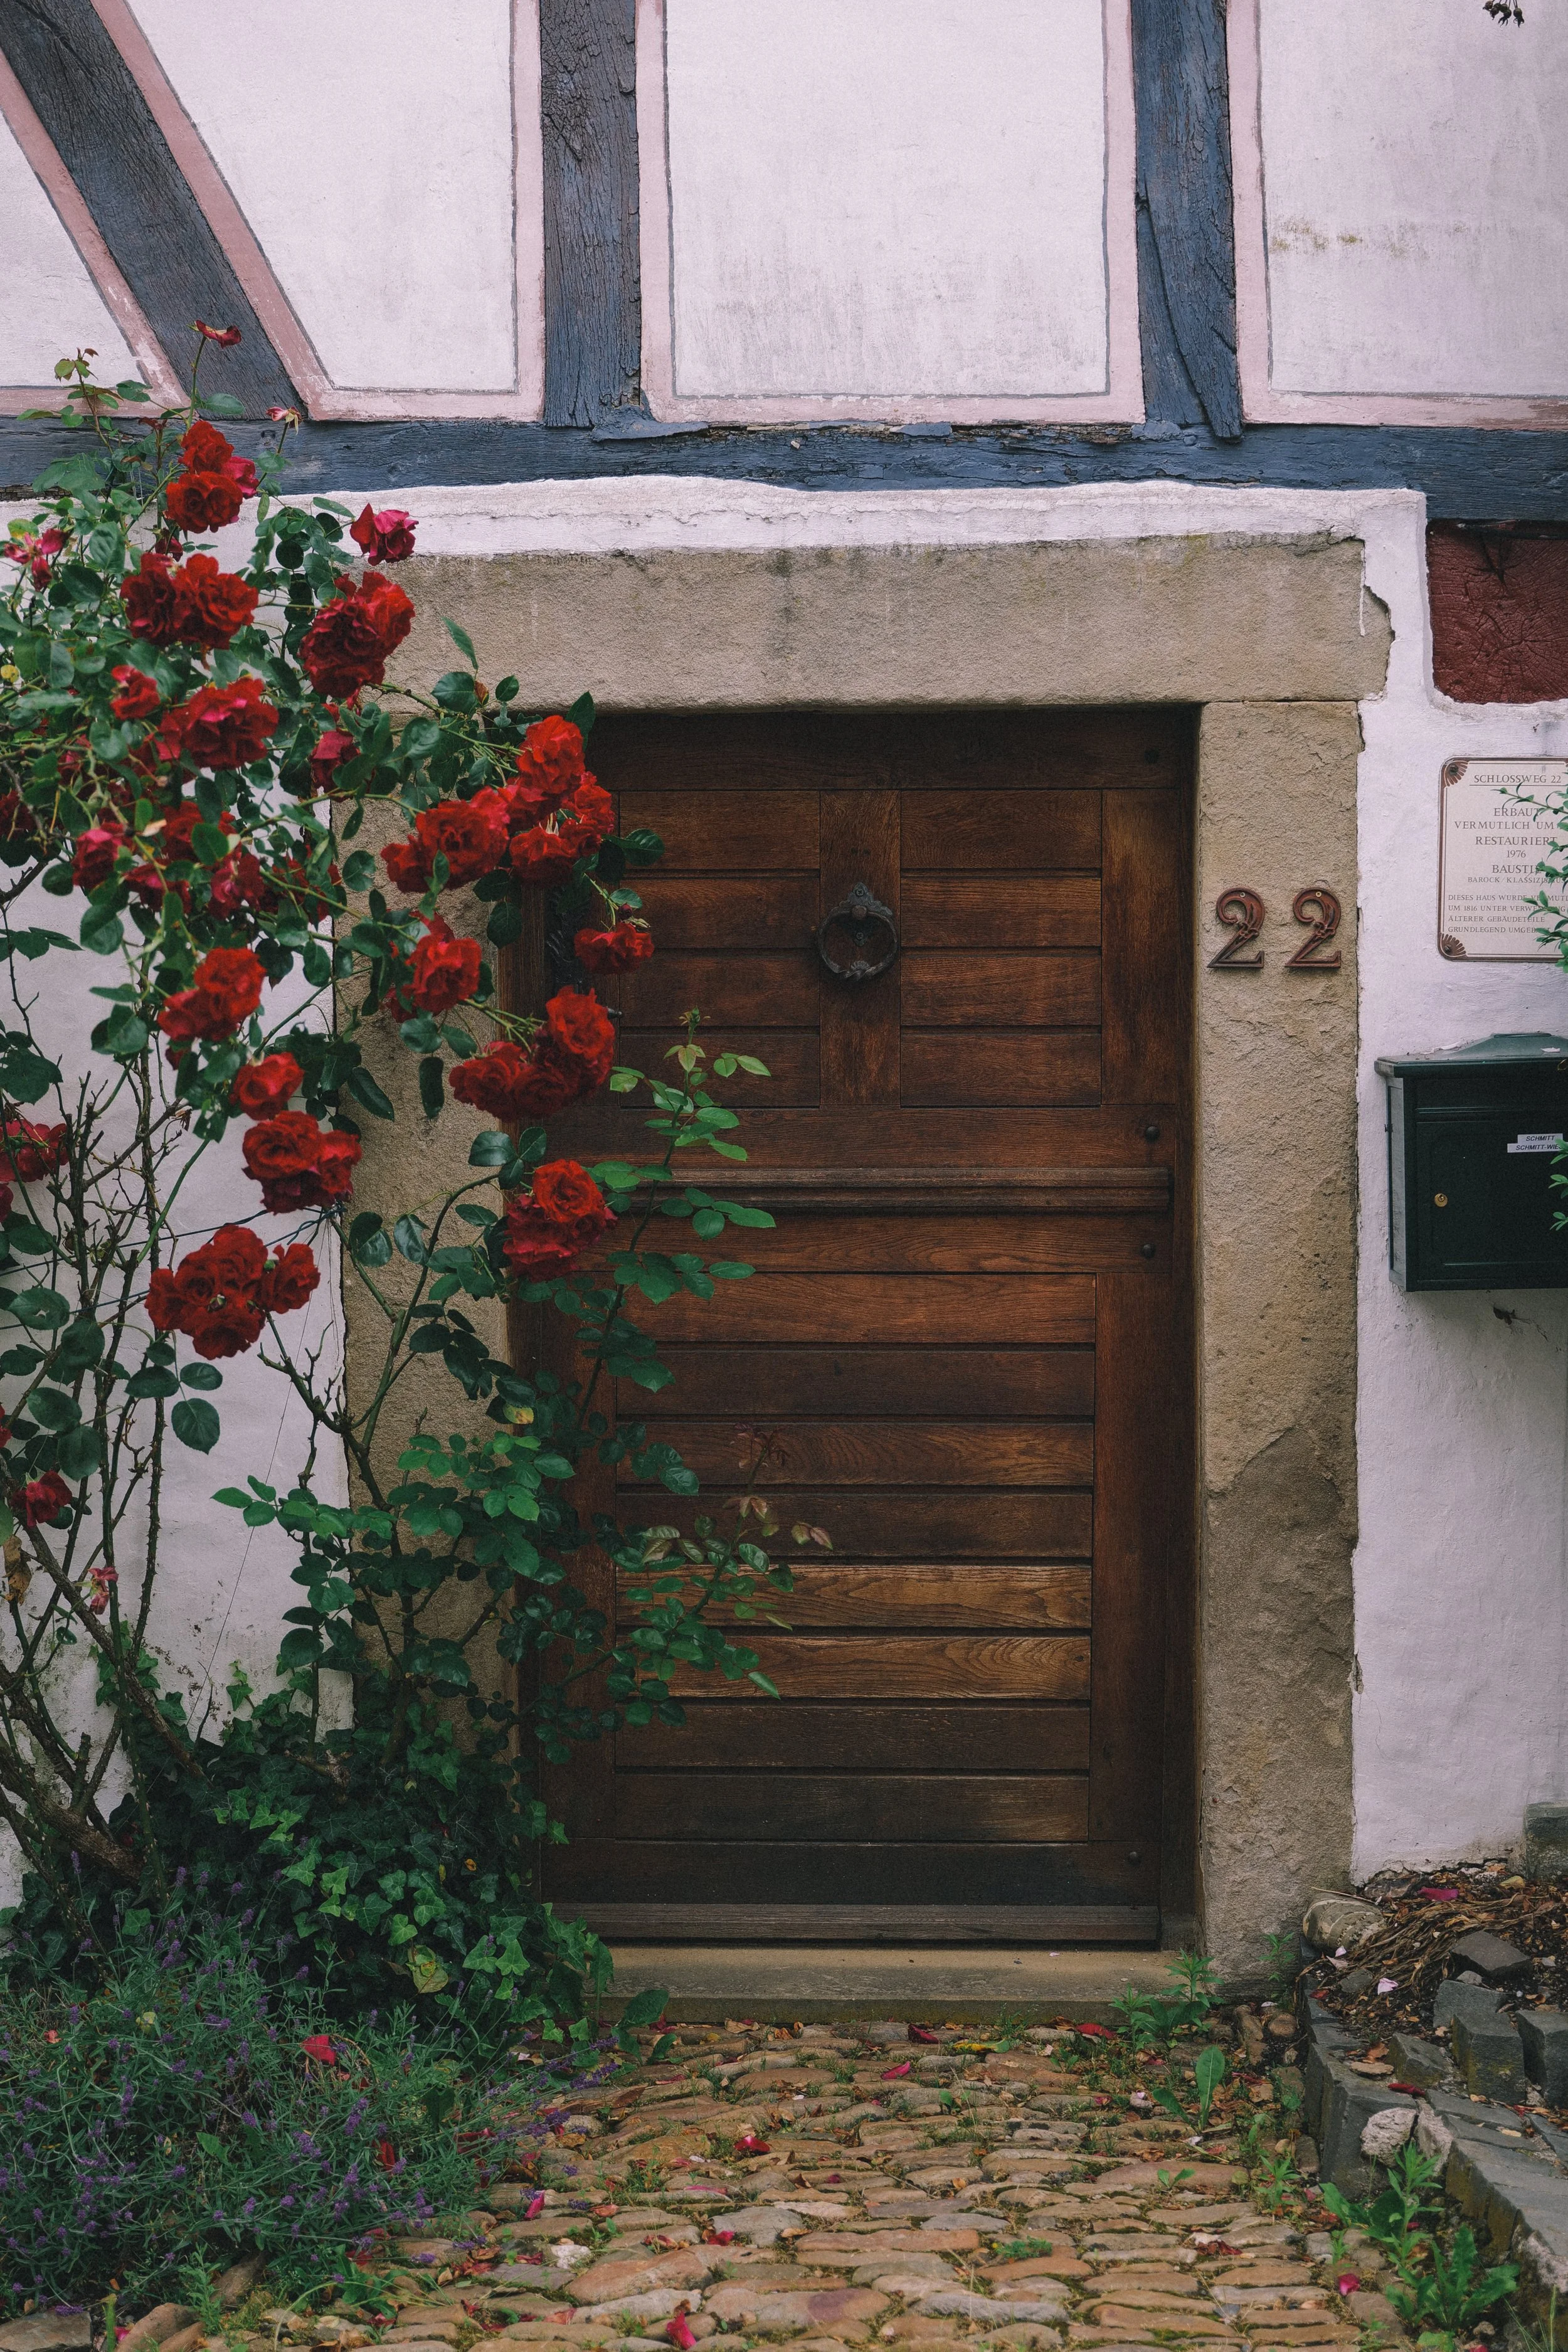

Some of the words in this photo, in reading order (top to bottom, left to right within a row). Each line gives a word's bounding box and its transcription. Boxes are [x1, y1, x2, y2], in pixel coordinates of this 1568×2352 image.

[1474, 775, 1547, 783] SCHLOSSWEG
[1550, 775, 1561, 783] 22
[1494, 808, 1539, 817] ERBAUT
[1454, 821, 1530, 830] VERMUTLICH
[1537, 822, 1554, 830] UM
[1475, 836, 1557, 845] RESTAURIERT
[1507, 850, 1526, 858] 1976
[1207, 887, 1342, 968] 22
